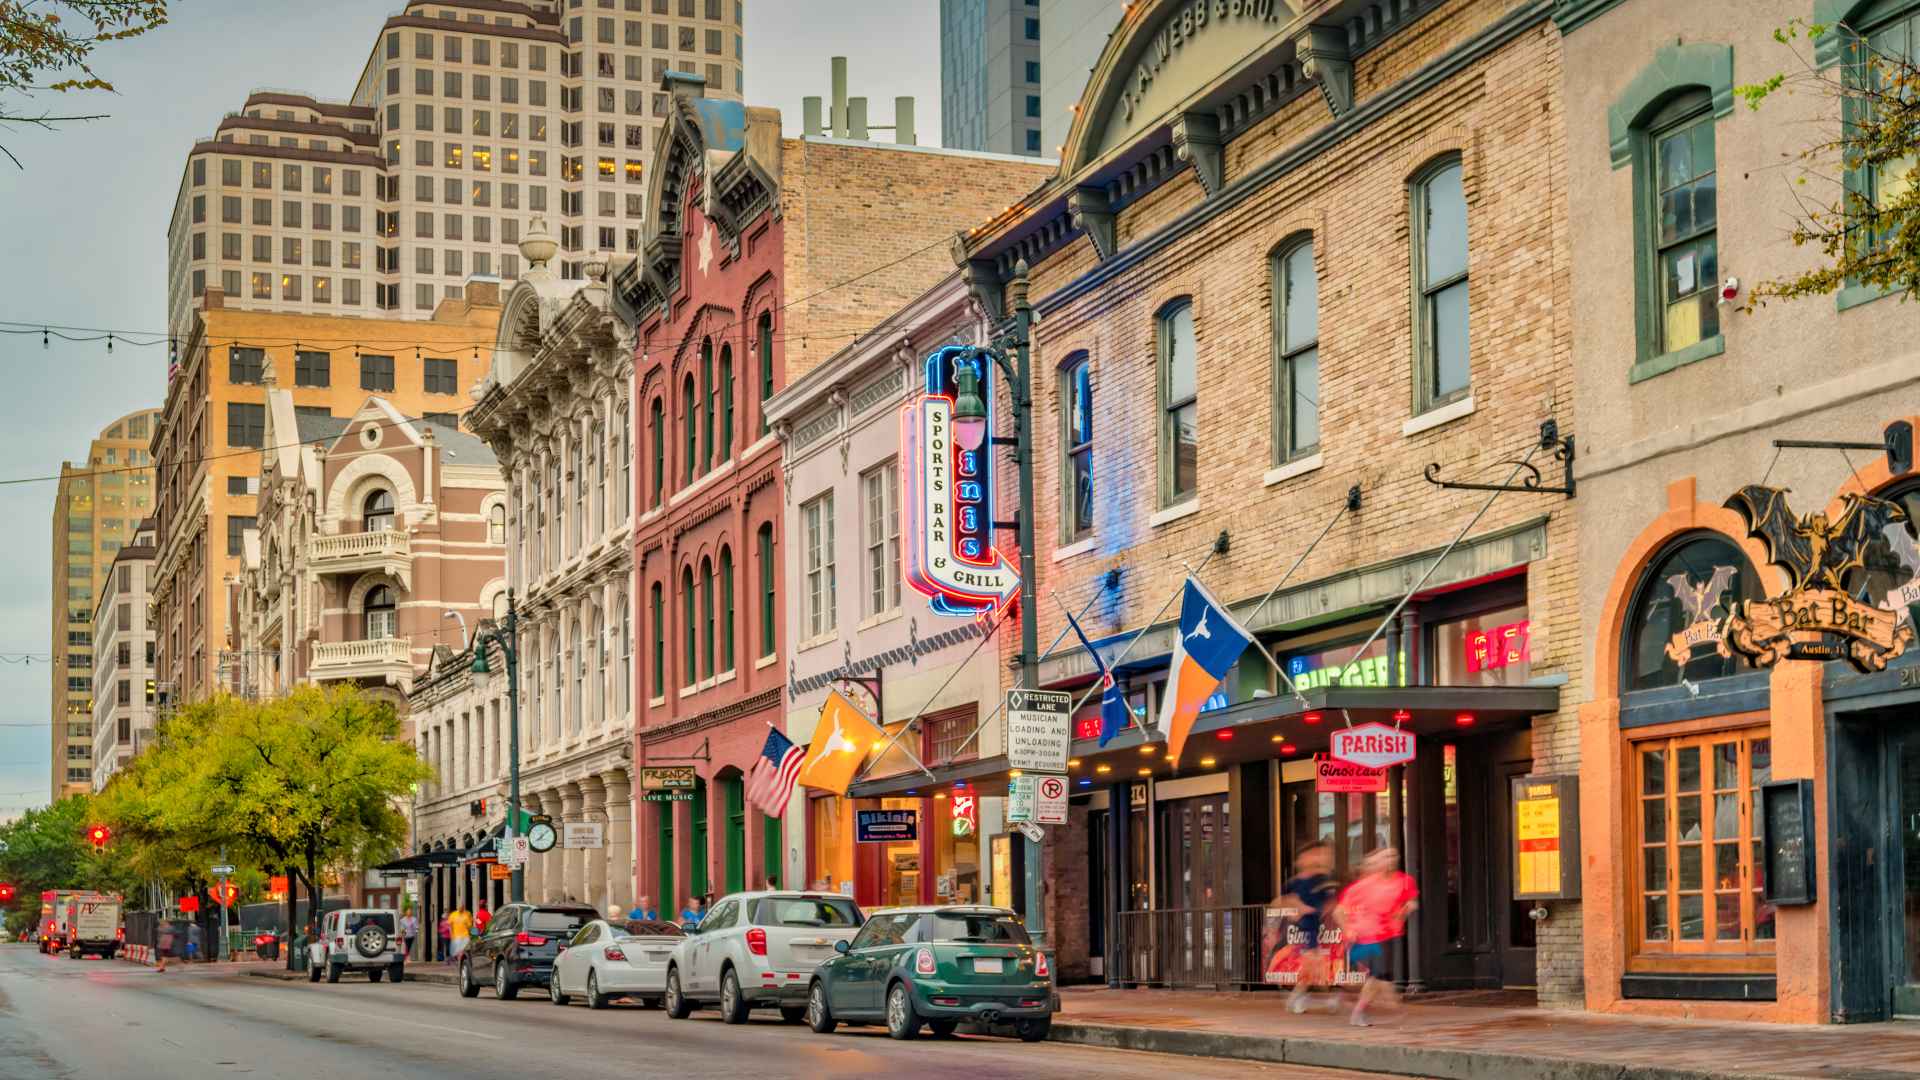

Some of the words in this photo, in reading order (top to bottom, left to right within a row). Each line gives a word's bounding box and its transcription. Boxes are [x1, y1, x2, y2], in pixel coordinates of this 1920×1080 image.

[932, 411, 944, 492] SPORTS
[933, 503, 945, 542] BAR
[934, 557, 946, 569] &
[953, 570, 1005, 588] GRILL
[1779, 600, 1822, 628] Bat
[1831, 599, 1875, 632] Bar
[1024, 693, 1069, 703] RESTRICTED
[1037, 702, 1057, 711] LANE
[1020, 713, 1058, 723] MUSICIAN
[1010, 725, 1046, 734] LOADING
[1051, 727, 1067, 736] AND
[1015, 738, 1062, 748] UNLOADING
